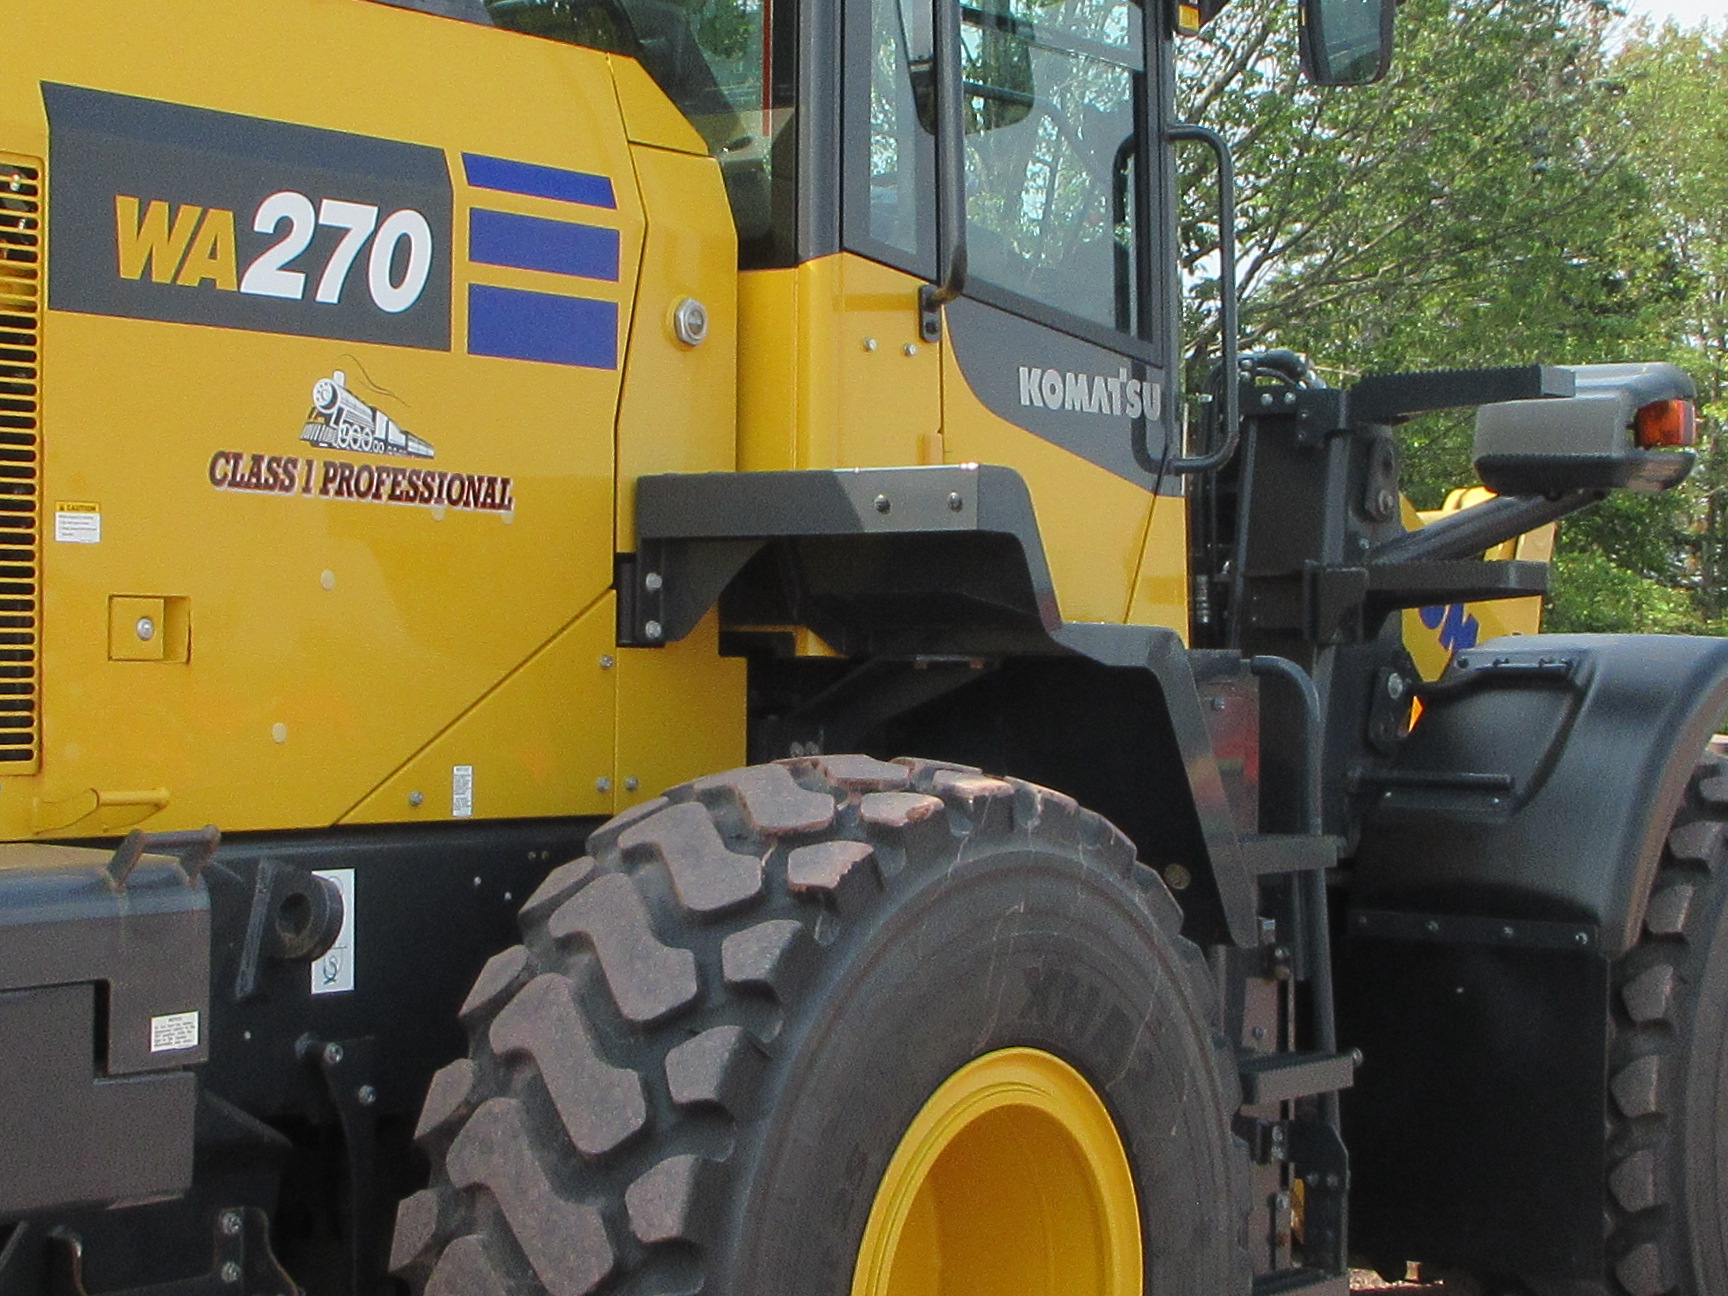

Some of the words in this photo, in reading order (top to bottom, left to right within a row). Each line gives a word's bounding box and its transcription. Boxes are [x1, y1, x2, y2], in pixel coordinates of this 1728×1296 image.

[1018, 366, 1162, 421] KOMATSU
[209, 450, 300, 494] CLASS
[319, 461, 514, 512] PROFESSIONAL
